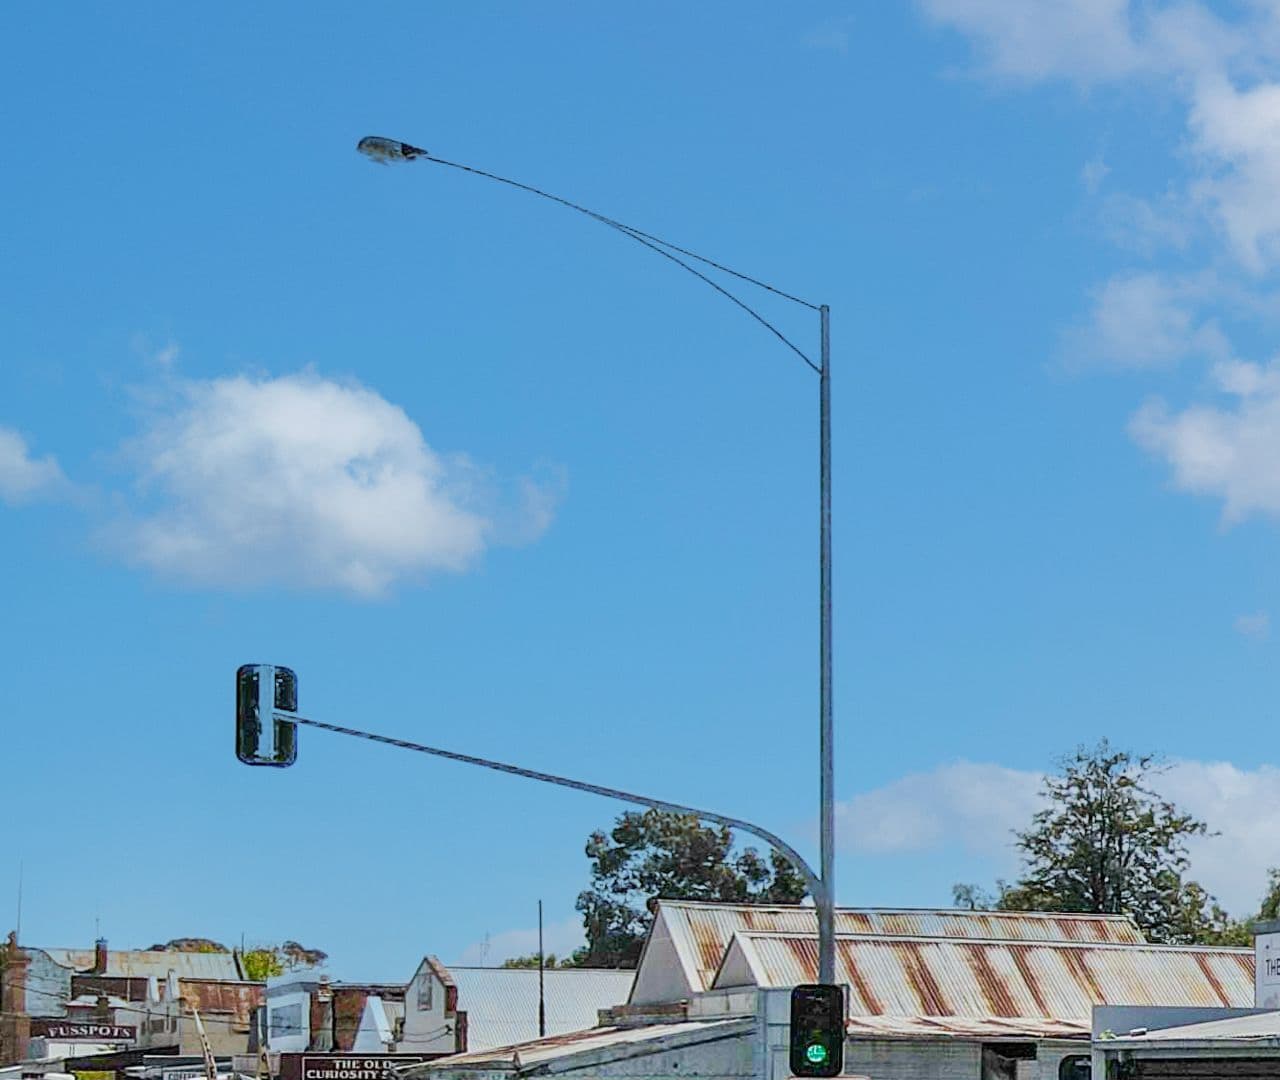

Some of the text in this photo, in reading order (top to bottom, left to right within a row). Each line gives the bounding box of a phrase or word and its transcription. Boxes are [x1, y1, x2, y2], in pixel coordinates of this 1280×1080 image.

[1266, 957, 1280, 976] THE
[49, 1026, 131, 1037] FUSSPOTS
[335, 1060, 392, 1069] THE OLD
[306, 1070, 378, 1079] CURIOSITY
